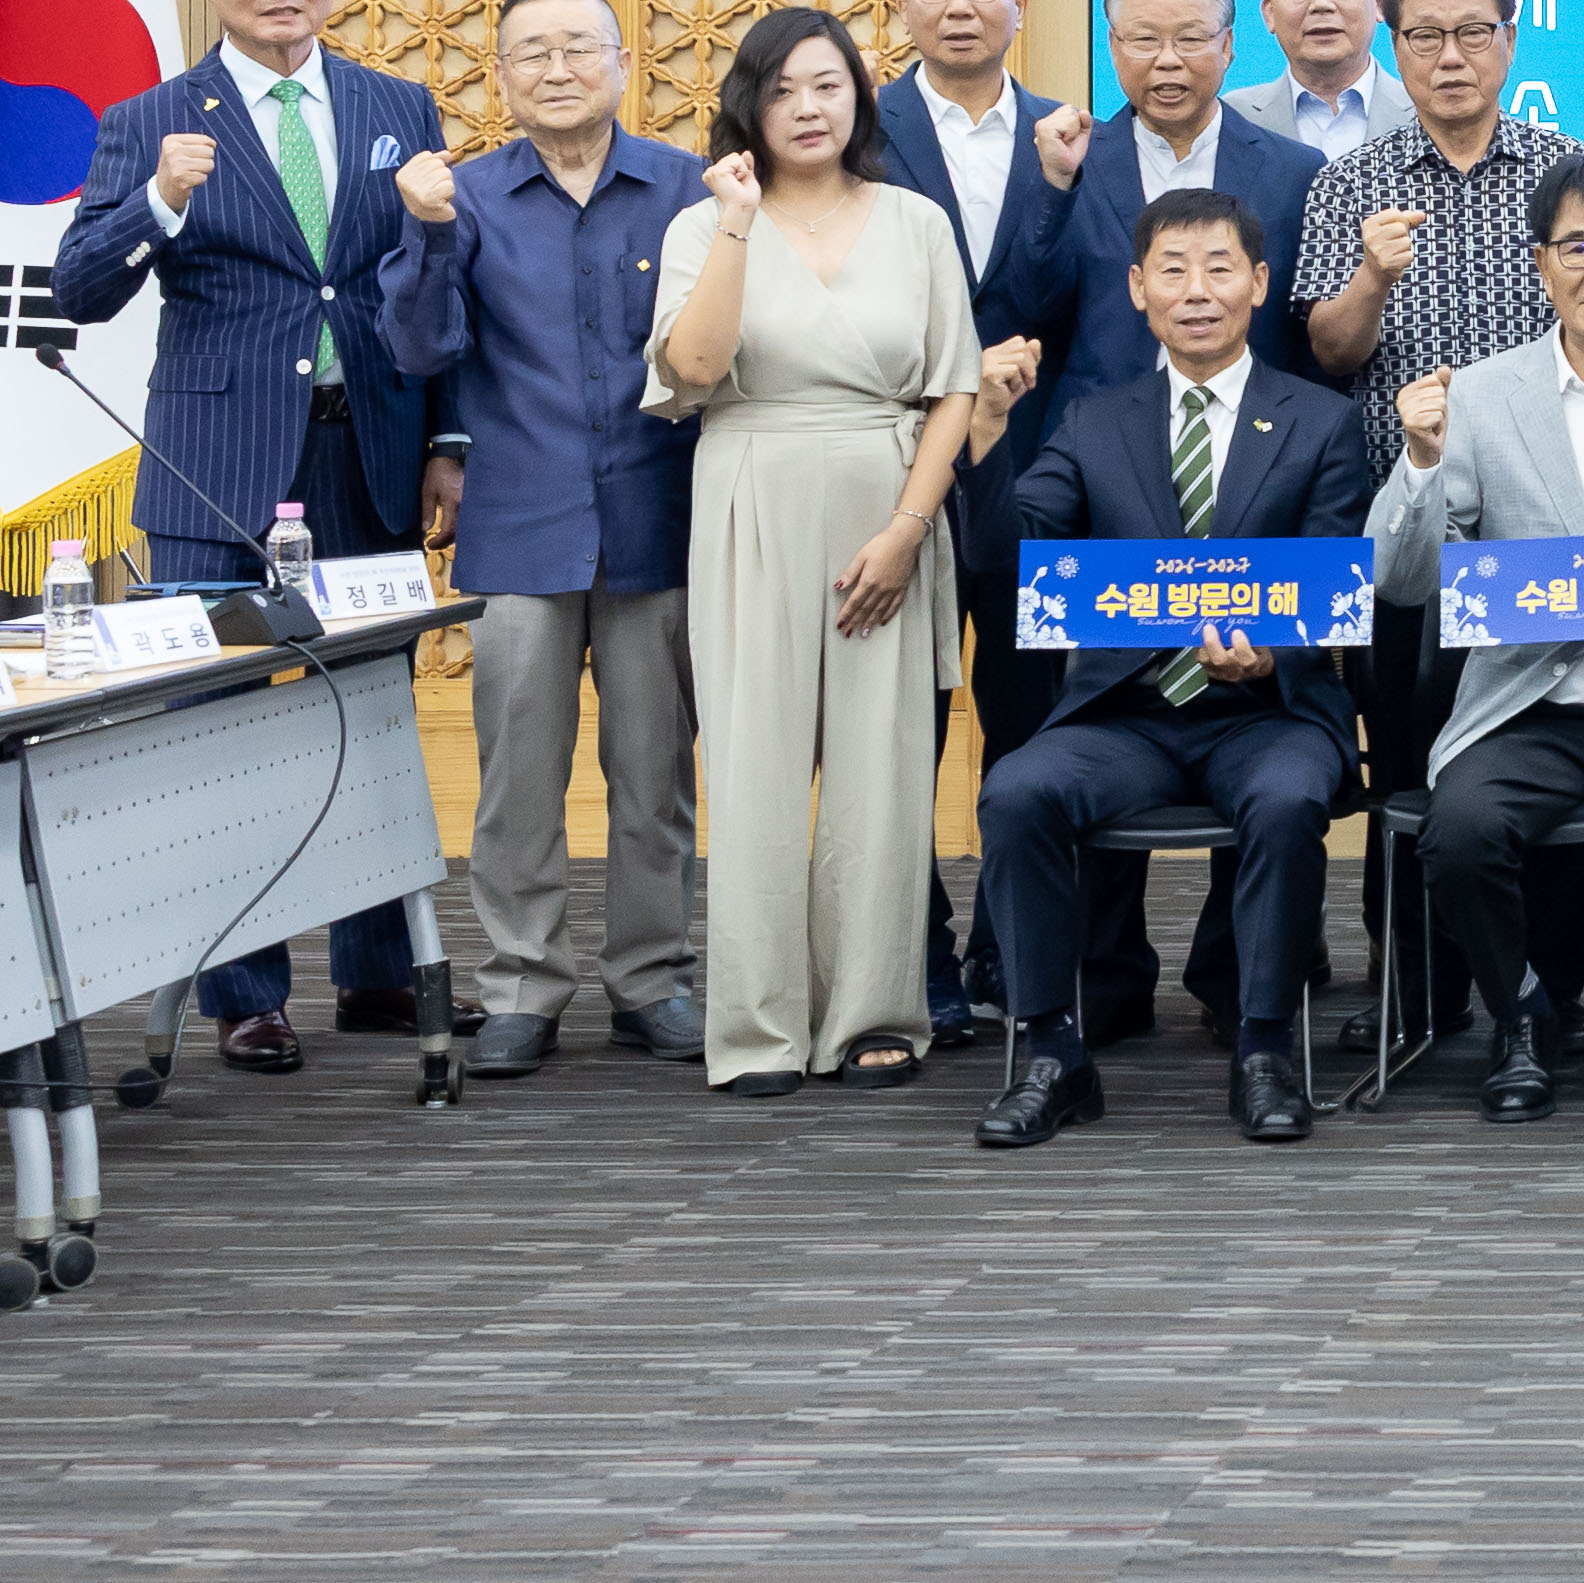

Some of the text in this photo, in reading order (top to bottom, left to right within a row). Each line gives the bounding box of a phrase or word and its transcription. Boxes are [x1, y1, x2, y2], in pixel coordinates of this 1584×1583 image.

[1095, 582, 1298, 618] 수원 방문의 해
[1516, 578, 1578, 613] 수원
